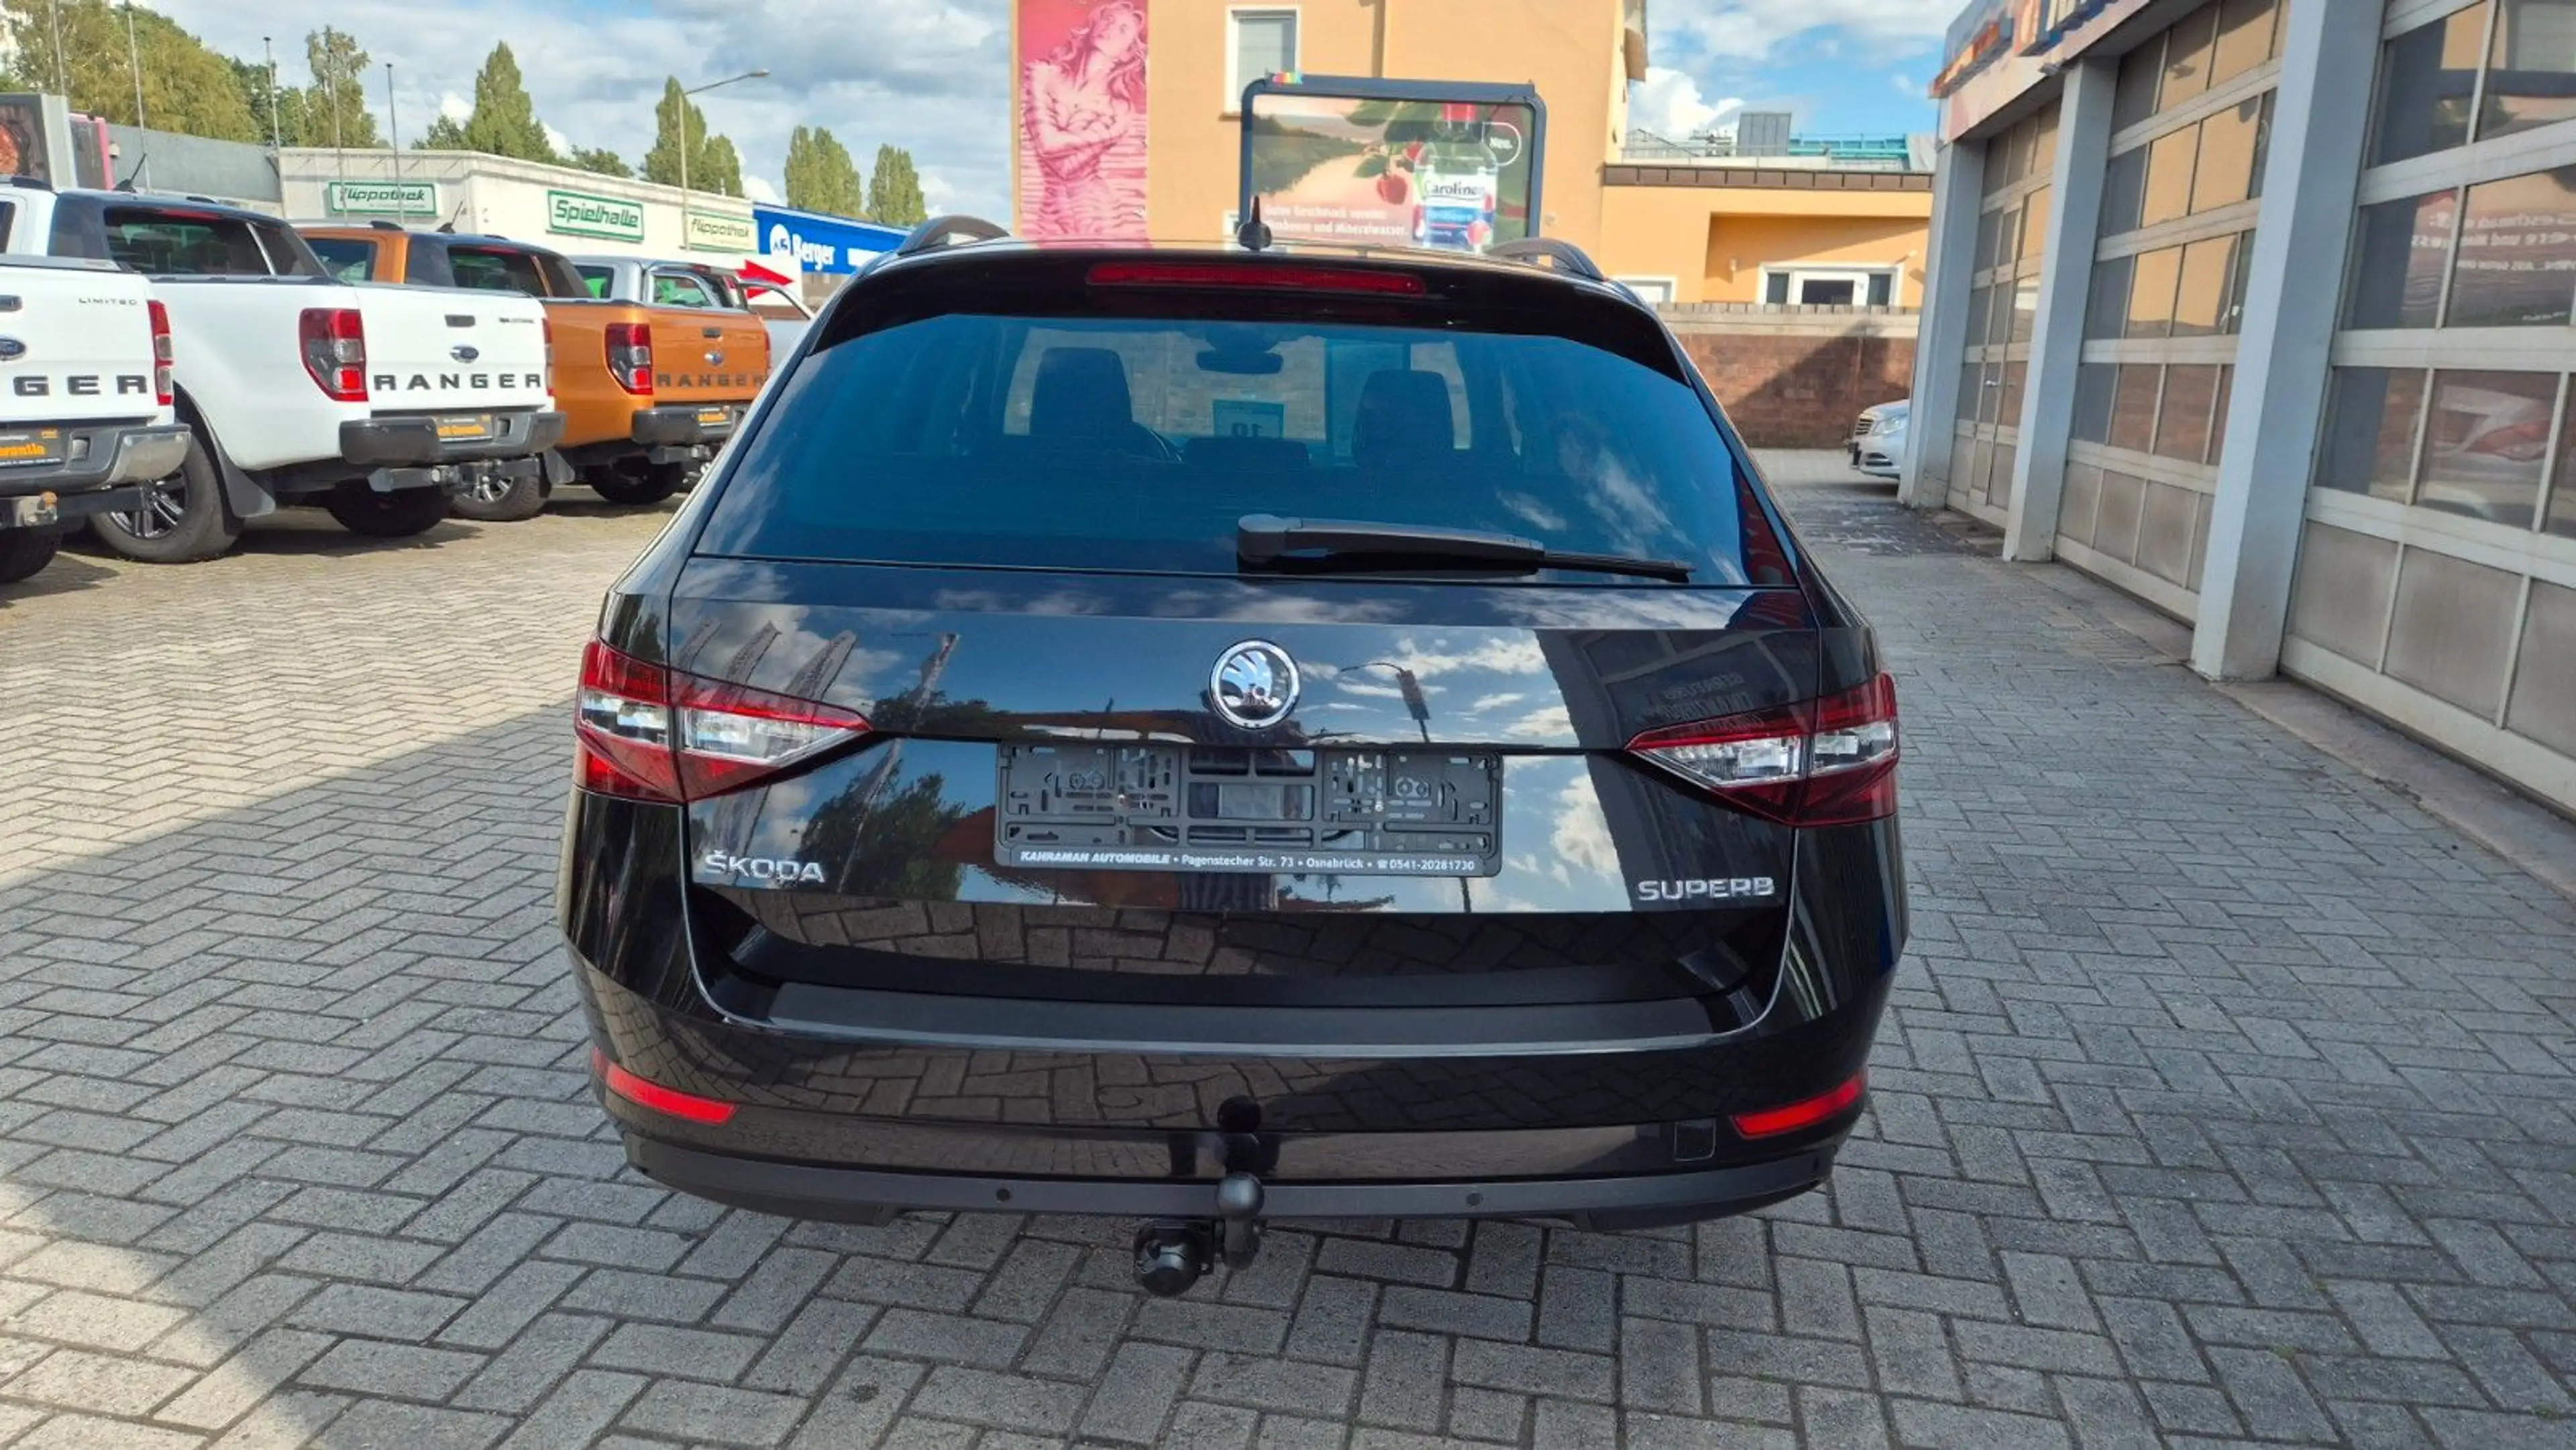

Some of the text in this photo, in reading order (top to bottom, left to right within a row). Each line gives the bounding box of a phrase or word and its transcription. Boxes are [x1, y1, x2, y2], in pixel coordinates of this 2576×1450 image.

[554, 199, 639, 228] Spielhalle
[792, 233, 835, 271] Berger
[78, 298, 138, 306] LIMITED
[13, 375, 148, 396] GER
[373, 374, 541, 391] RANGER
[657, 374, 764, 387] RANGER
[704, 849, 825, 884] ŠKODA
[1020, 850, 1089, 862] KAHRAMAN
[1091, 852, 1171, 865] AUTOMOBILE
[1182, 854, 1254, 868] Pagenstecher
[1258, 856, 1276, 867] Str.
[1281, 856, 1294, 867] 73
[1307, 856, 1364, 869] Osnabrück
[1638, 877, 1776, 901] SUPERB
